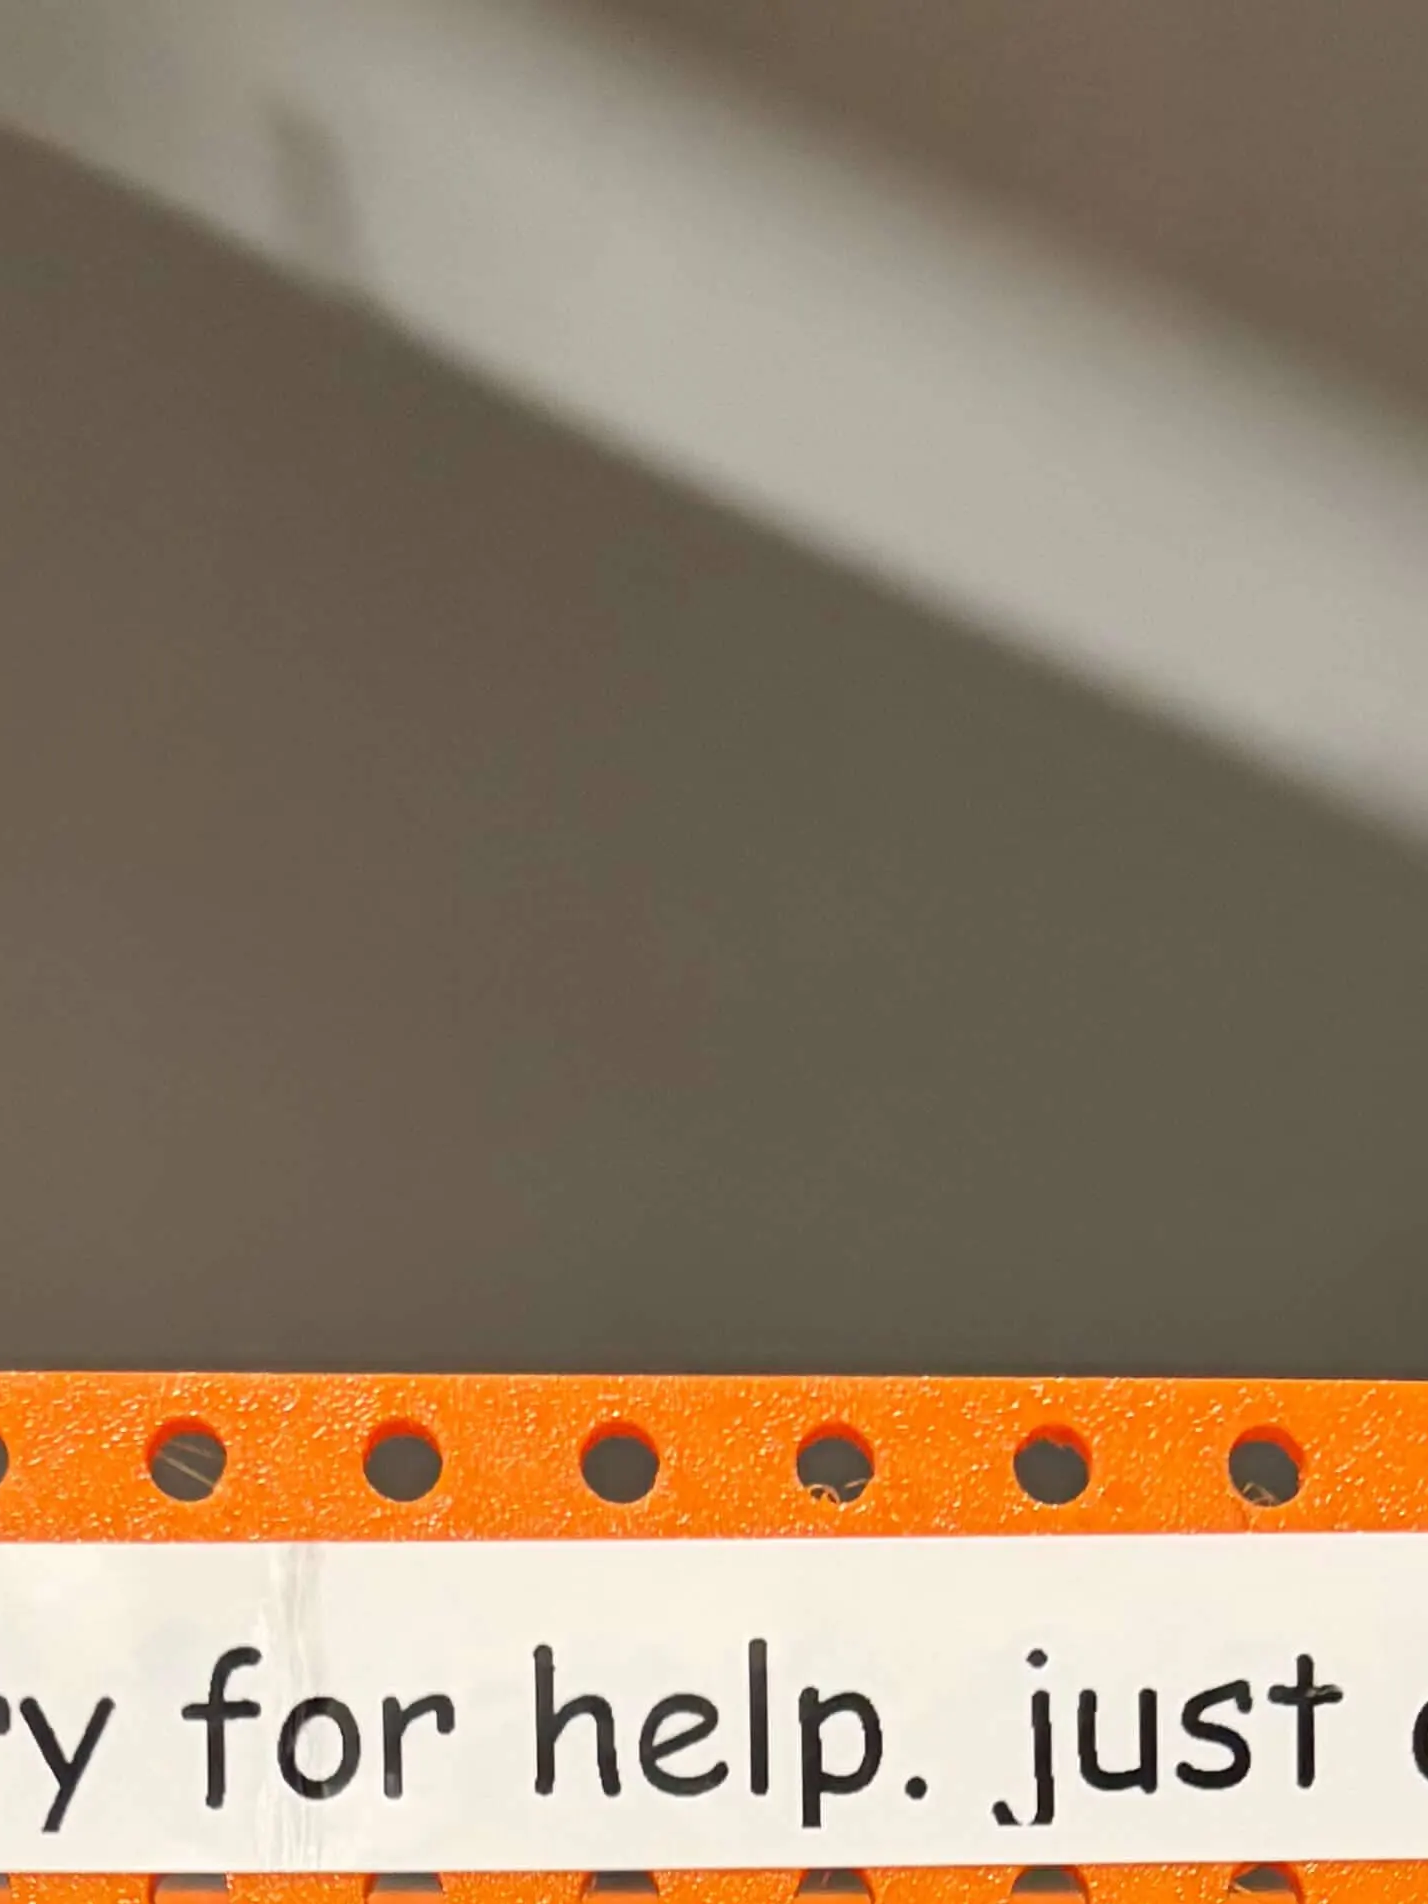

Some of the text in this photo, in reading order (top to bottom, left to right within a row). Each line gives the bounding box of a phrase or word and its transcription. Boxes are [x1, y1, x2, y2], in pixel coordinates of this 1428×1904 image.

[181, 1646, 455, 1809] for
[533, 1638, 928, 1828] help.
[992, 1649, 1343, 1826] just
